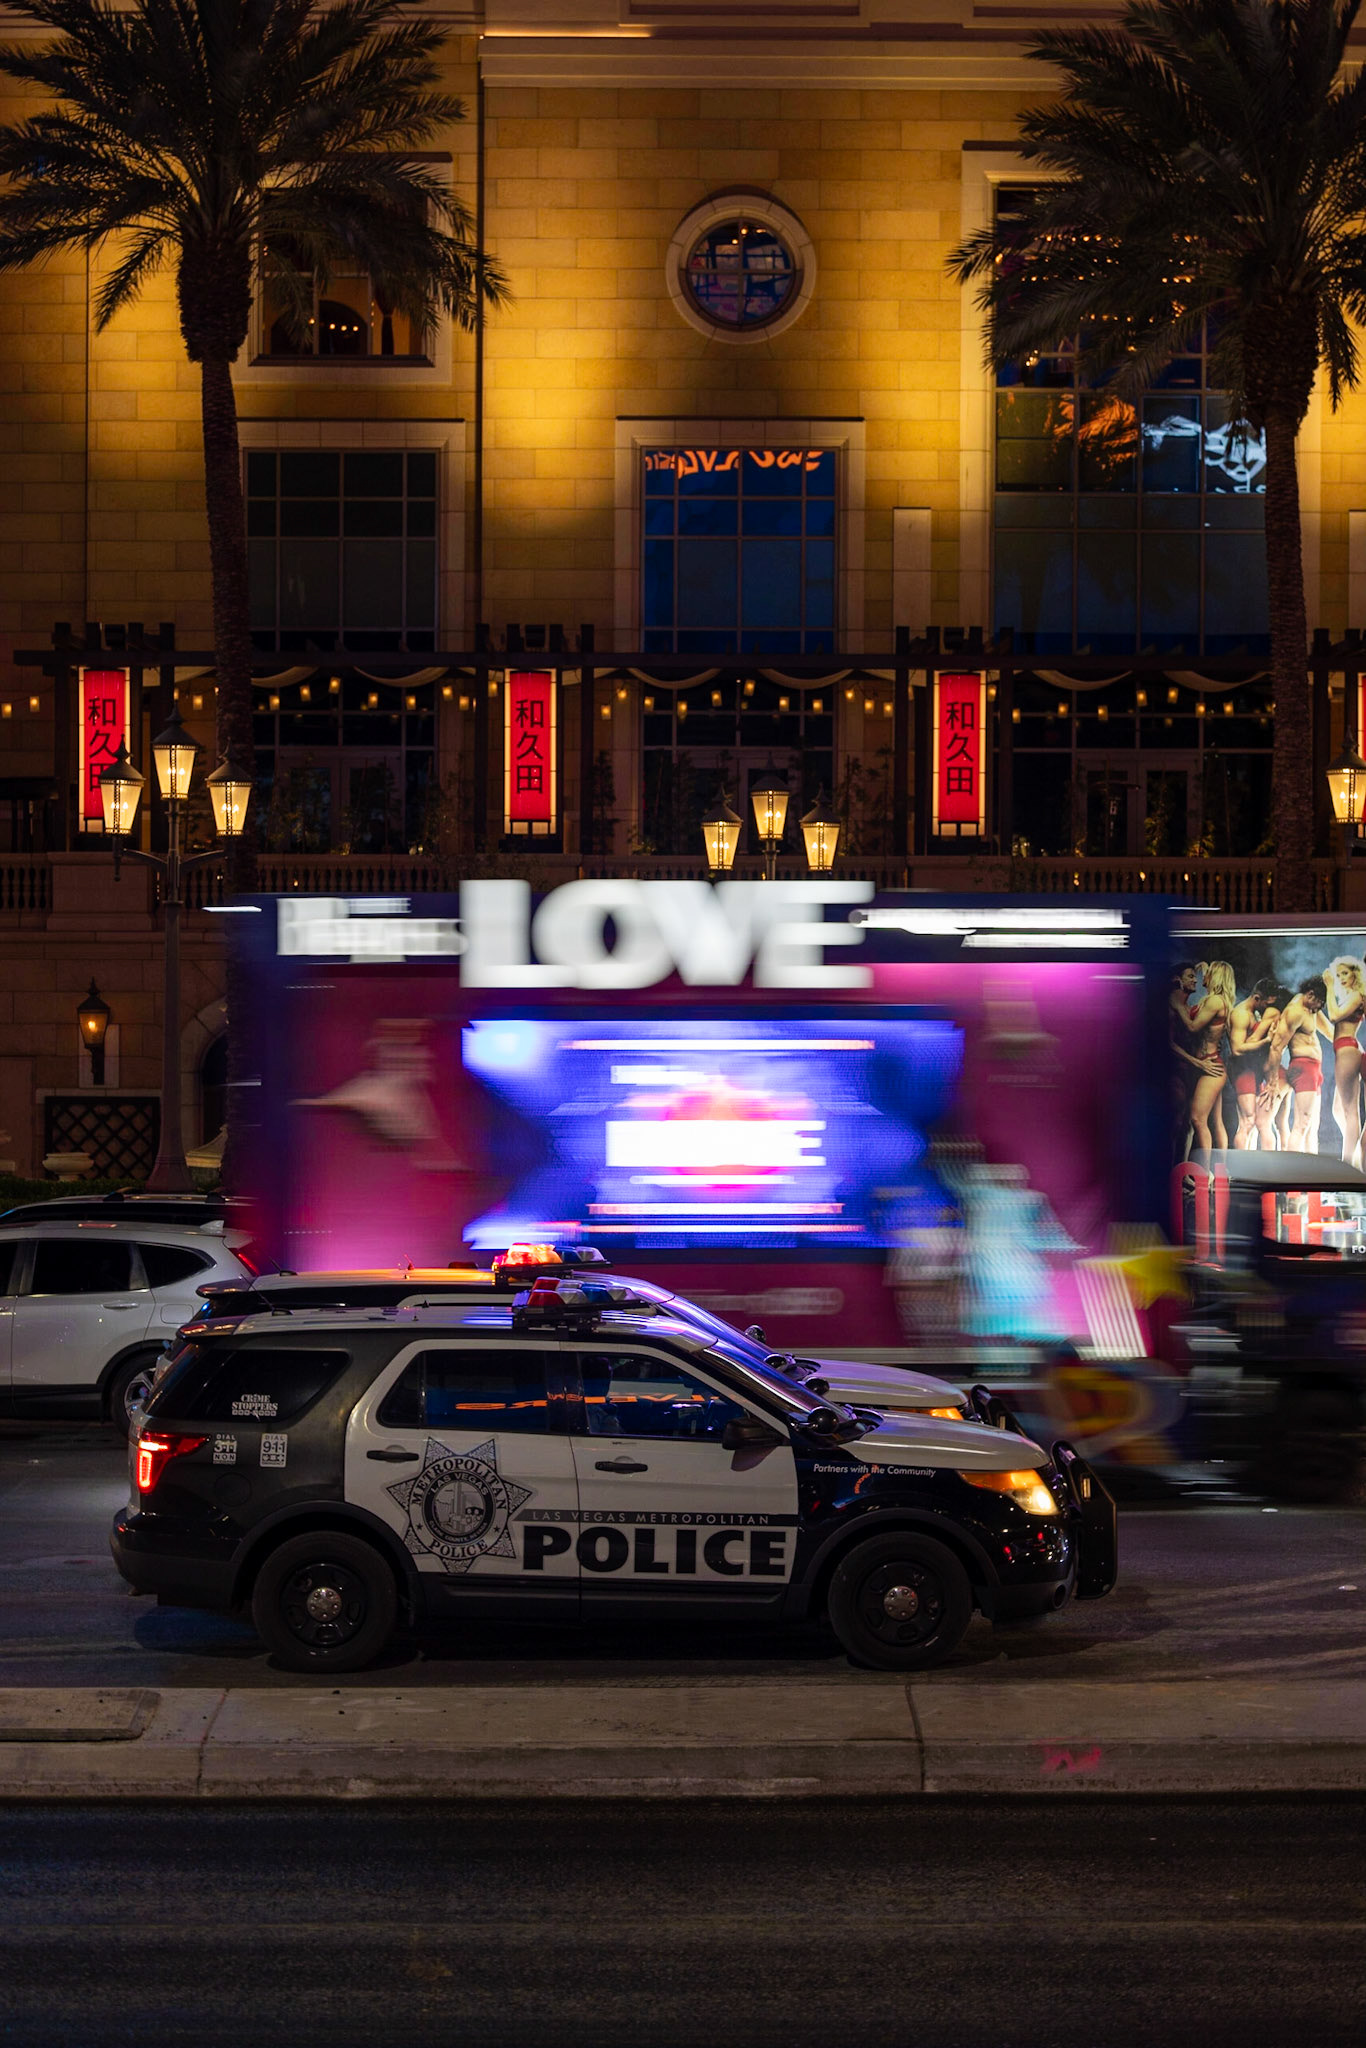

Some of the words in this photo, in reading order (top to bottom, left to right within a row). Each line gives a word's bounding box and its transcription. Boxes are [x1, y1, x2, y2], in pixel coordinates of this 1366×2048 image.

[515, 699, 544, 795] 和久田
[946, 701, 975, 796] 和久田
[459, 879, 875, 990] LOVE
[232, 1402, 278, 1410] STOPPERS
[412, 1459, 507, 1508] METROPOLITAN
[431, 1475, 452, 1494] LAS
[454, 1472, 489, 1496] VEGAS
[813, 1464, 848, 1472] Partners
[850, 1465, 869, 1474] with
[871, 1466, 885, 1474] the
[887, 1466, 936, 1477] Community
[532, 1511, 561, 1521] LAS
[571, 1512, 626, 1523] VEGAS
[636, 1514, 769, 1525] METROPOLITAN
[429, 1540, 487, 1557] POLICE
[523, 1525, 786, 1576] POLICE
